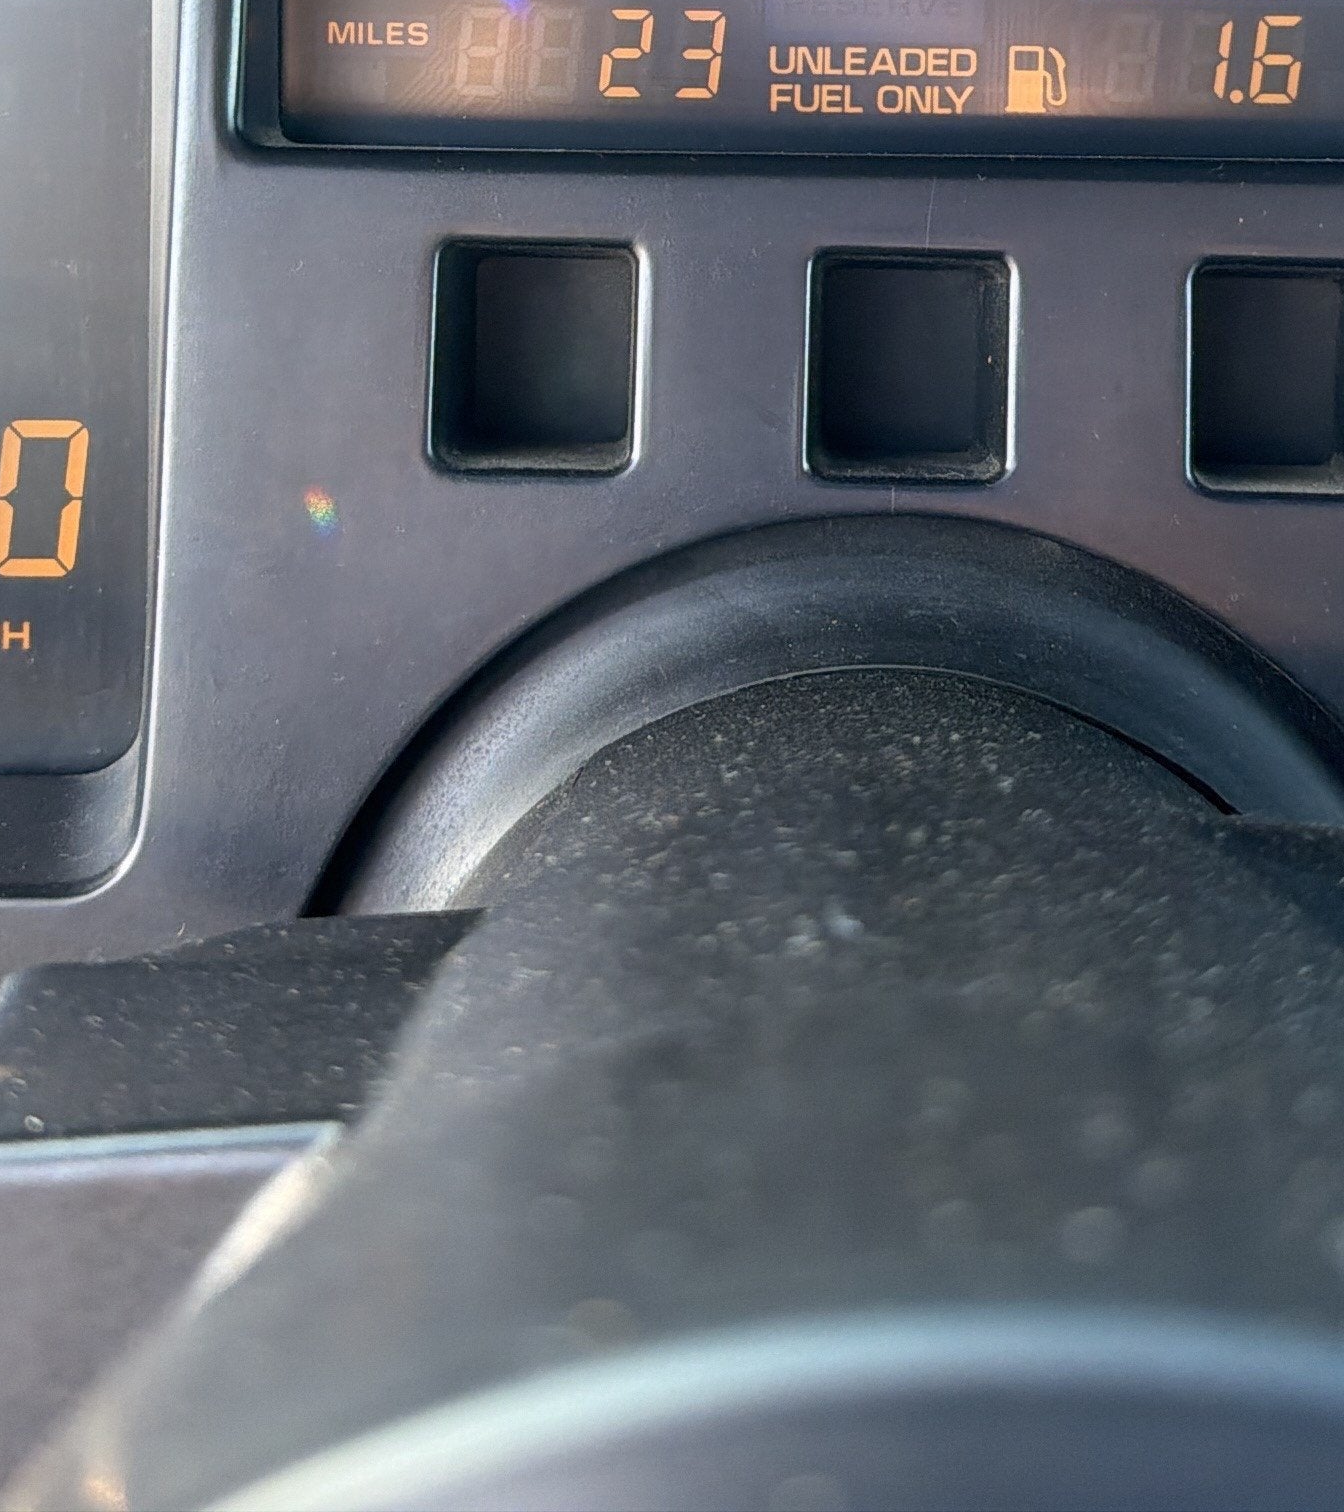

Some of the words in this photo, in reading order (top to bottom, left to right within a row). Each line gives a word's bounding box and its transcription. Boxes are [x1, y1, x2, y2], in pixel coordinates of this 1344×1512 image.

[328, 21, 430, 46] MILES
[599, 9, 725, 98] 23
[770, 47, 978, 77] UNLEADED
[1214, 16, 1302, 105] 1.6
[770, 84, 863, 113] FUEL
[877, 85, 975, 114] ONLY
